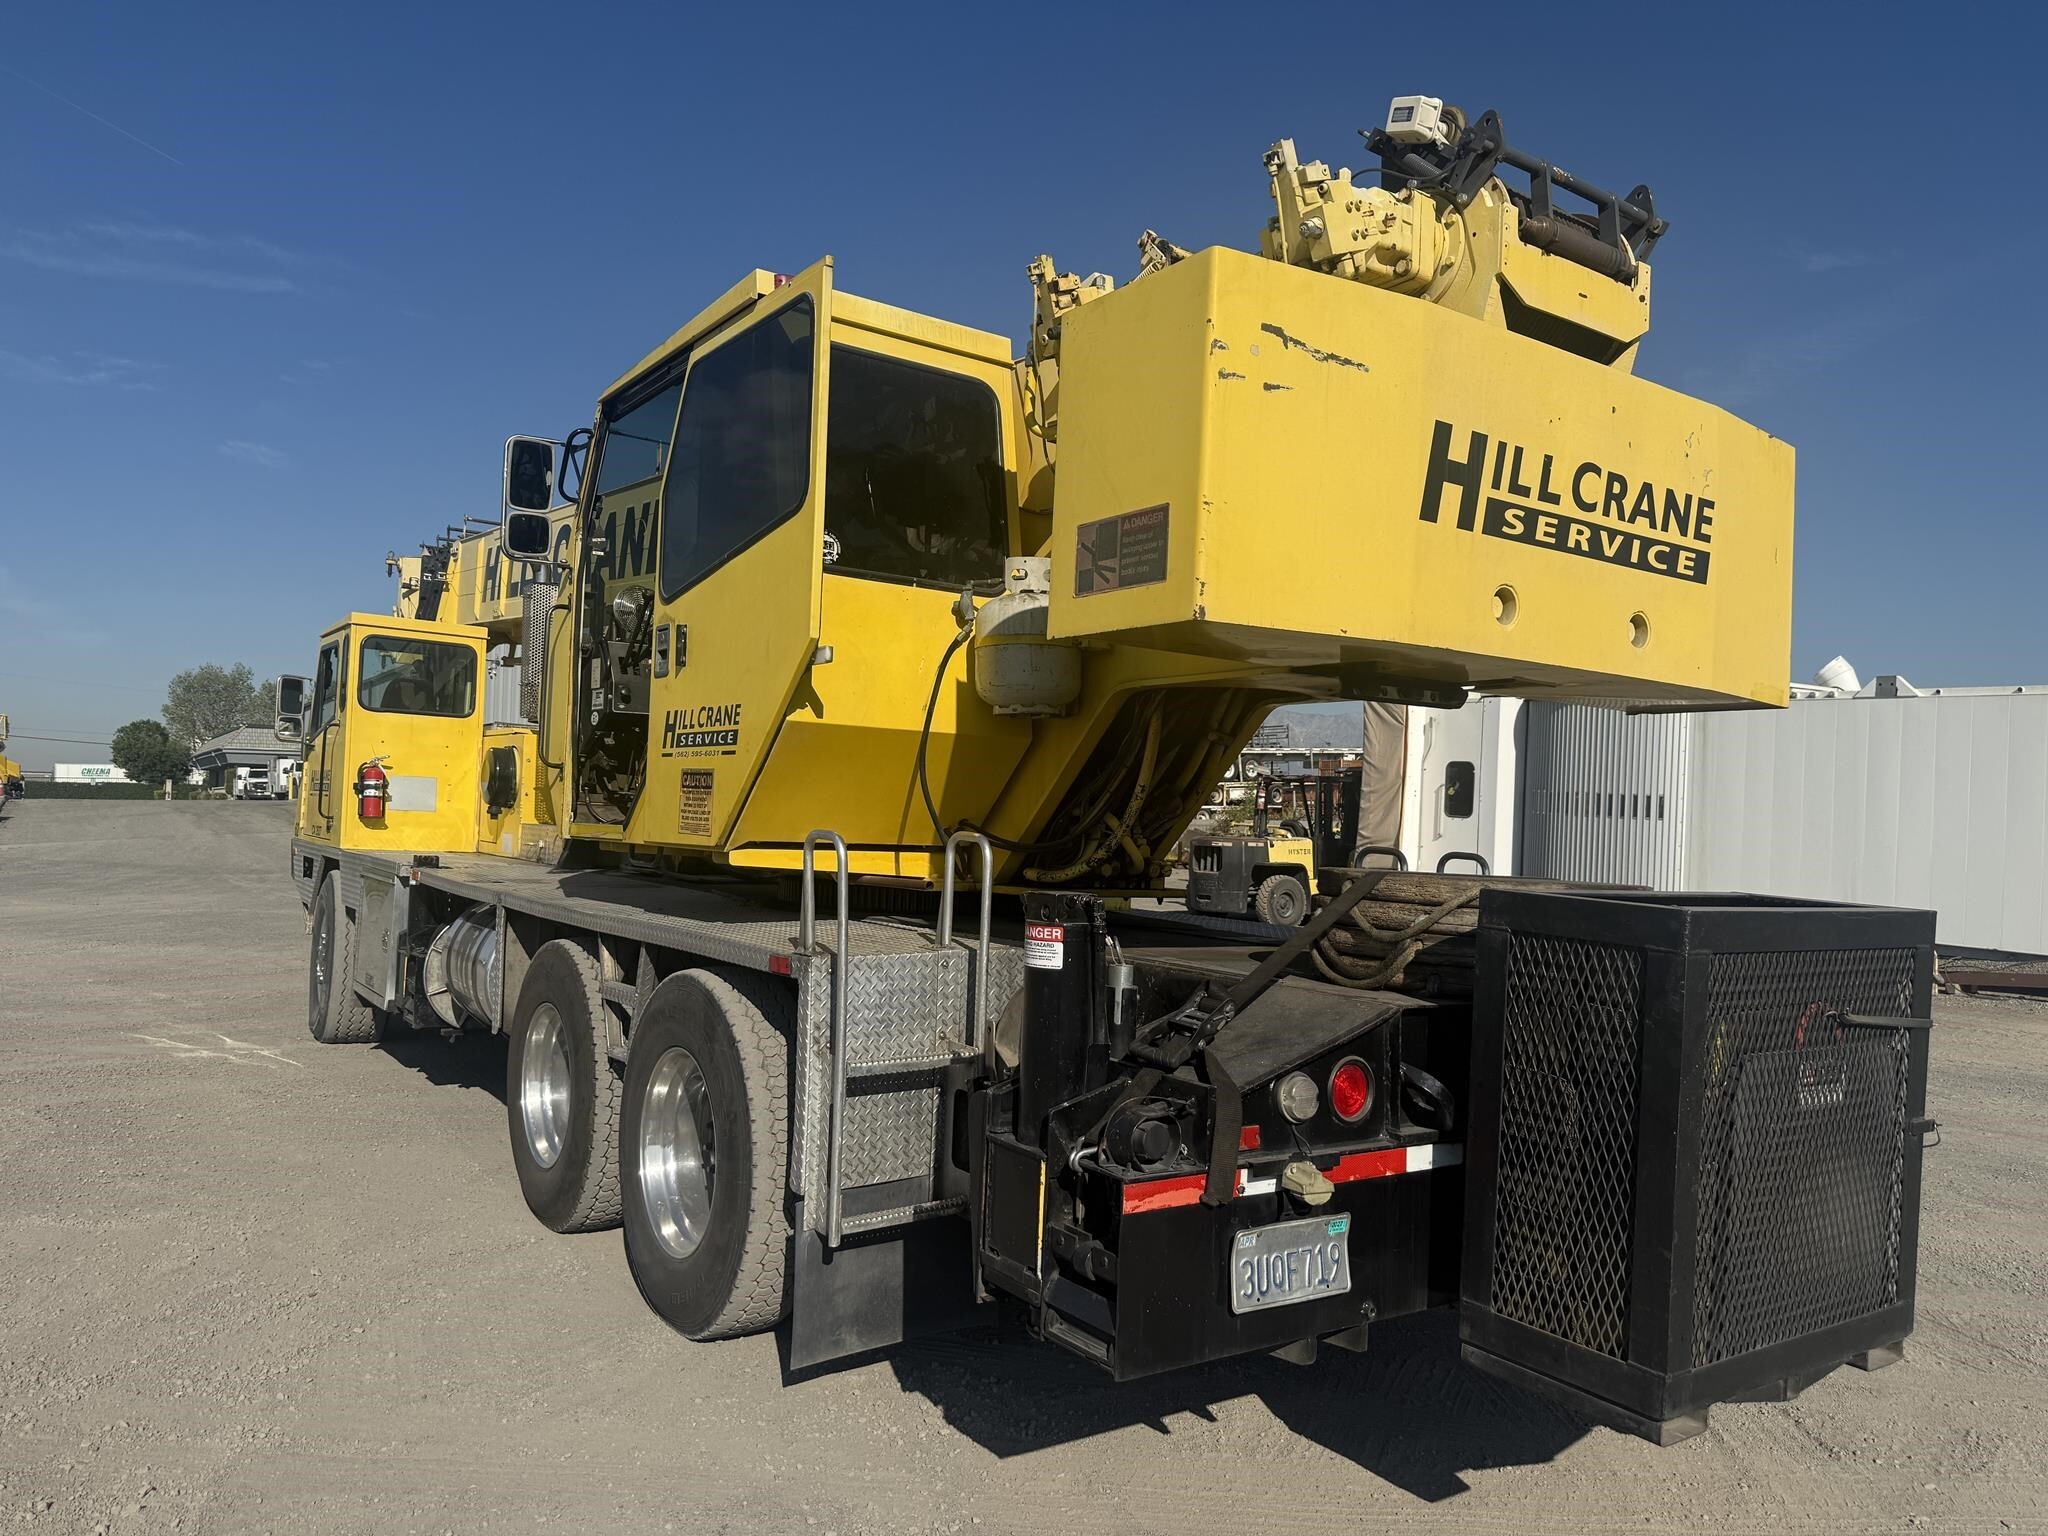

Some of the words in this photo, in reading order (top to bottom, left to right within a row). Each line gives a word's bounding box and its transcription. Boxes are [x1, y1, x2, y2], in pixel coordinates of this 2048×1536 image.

[1419, 419, 1562, 532] HILL
[1571, 461, 1715, 543] CRANE
[1501, 507, 1697, 576] SERVICE
[662, 709, 696, 749] HILL
[697, 703, 741, 729] CRANE
[680, 732, 734, 745] SERVICE
[683, 774, 711, 787] CAUTION
[1025, 926, 1061, 939] ANGER
[1240, 1242, 1341, 1298] 3UQF719
